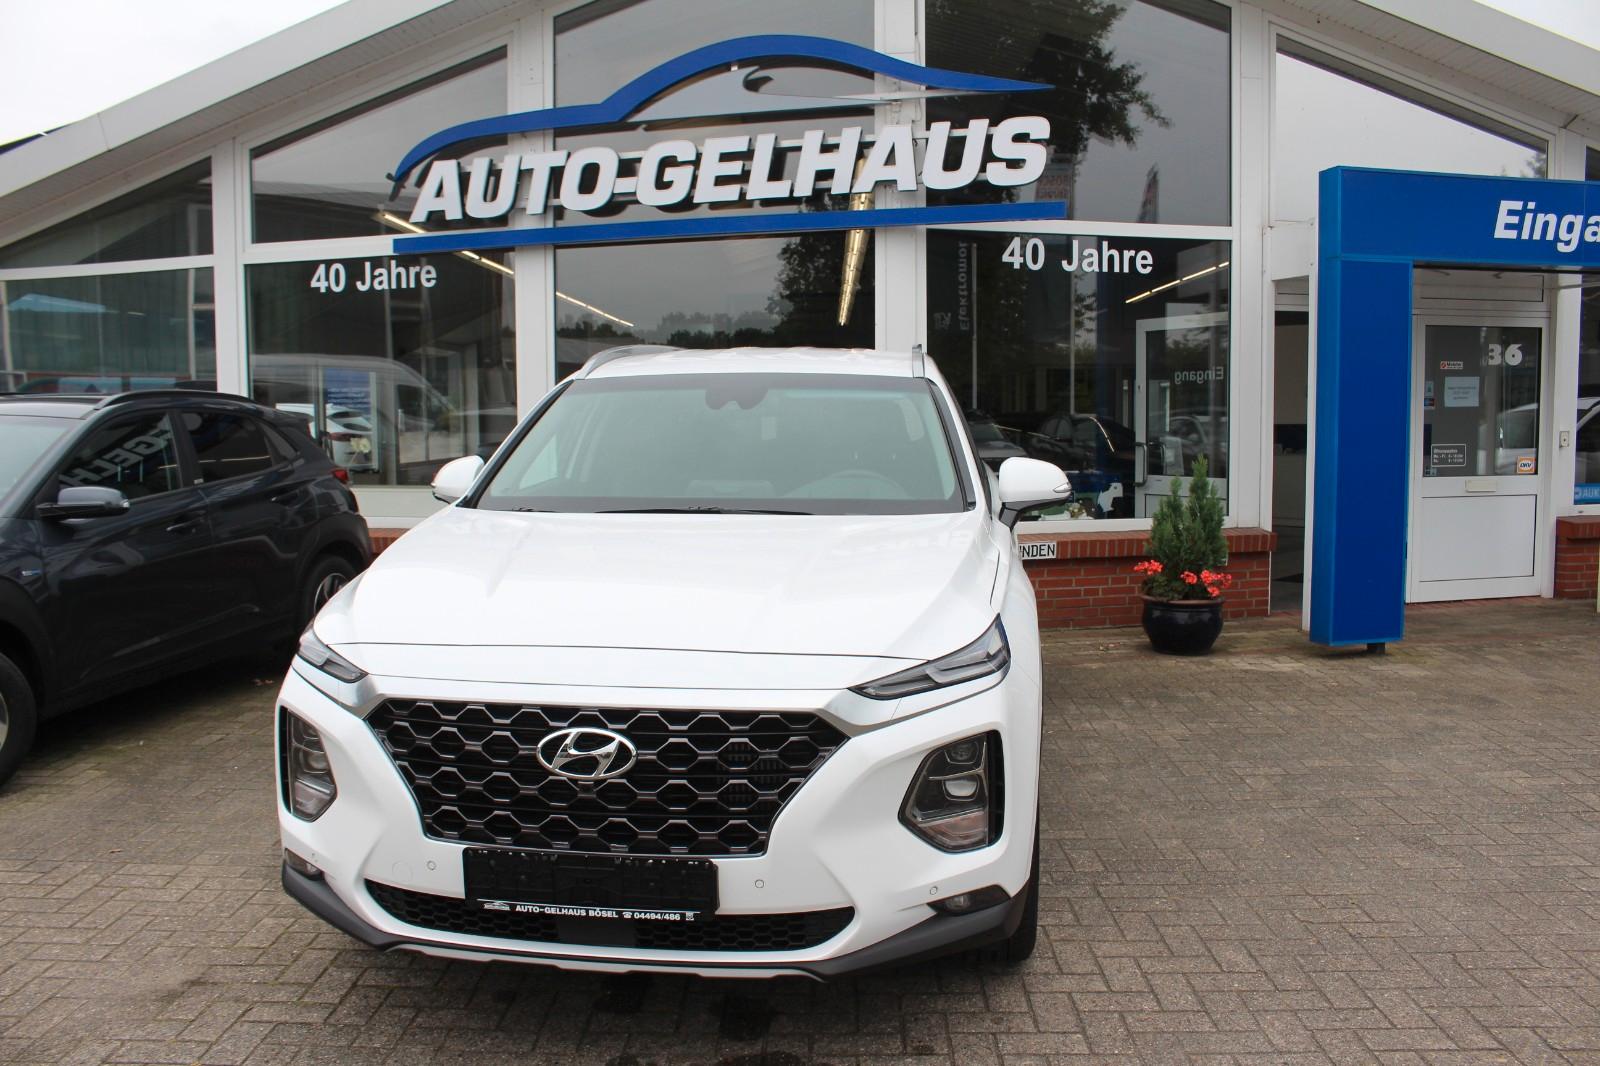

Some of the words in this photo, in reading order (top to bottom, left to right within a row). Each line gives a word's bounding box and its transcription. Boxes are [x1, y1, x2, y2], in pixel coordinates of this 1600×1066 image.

[409, 115, 1051, 224] AUTO-GELHAUS
[1001, 237, 1045, 271] 40
[1061, 239, 1153, 275] Jahre
[310, 263, 346, 293] 40
[355, 259, 438, 292] Jahre
[1487, 343, 1523, 366] 36
[1019, 543, 1056, 558] NDEN
[515, 904, 587, 917] AUTO-GELHAUS
[588, 907, 619, 918] BÖSEL
[633, 911, 681, 921] 04494/486
